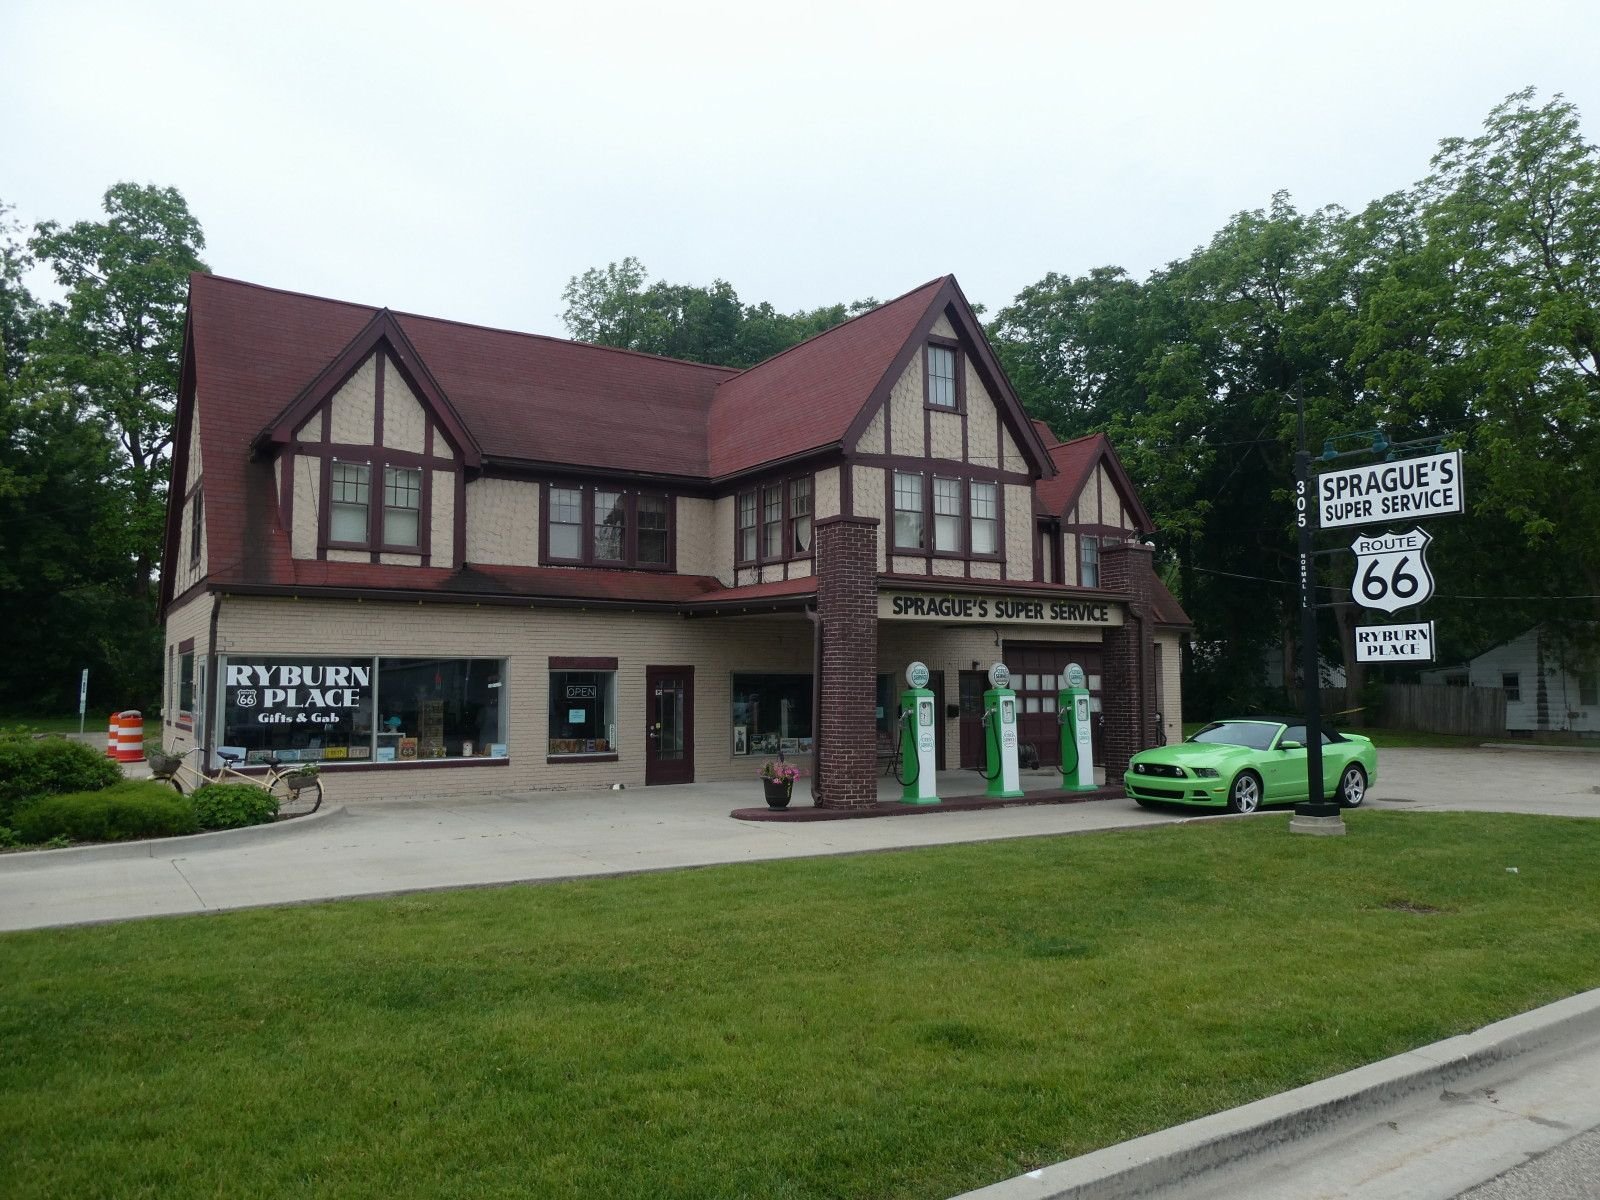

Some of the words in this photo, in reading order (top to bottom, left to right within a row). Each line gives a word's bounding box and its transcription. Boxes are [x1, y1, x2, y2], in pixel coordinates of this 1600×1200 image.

[1323, 459, 1454, 501] SPRAGUE'S
[1296, 480, 1306, 527] 305
[1325, 500, 1372, 522] SUPER
[1381, 488, 1454, 514] SERVICE
[1360, 536, 1417, 552] ROUTE
[1362, 556, 1419, 600] 66
[892, 596, 988, 618] SPRAGUE'S
[995, 601, 1044, 620] SUPER
[1050, 603, 1109, 622] SERVICE
[1358, 628, 1428, 643] RYBURN
[1367, 643, 1420, 656] PLACE
[226, 664, 371, 687] RYBURN
[240, 694, 254, 704] 66
[264, 688, 360, 708] PLACE
[567, 687, 596, 697] OPEN
[258, 713, 293, 723] Gifts
[296, 713, 308, 723] &
[311, 713, 340, 723] Gab
